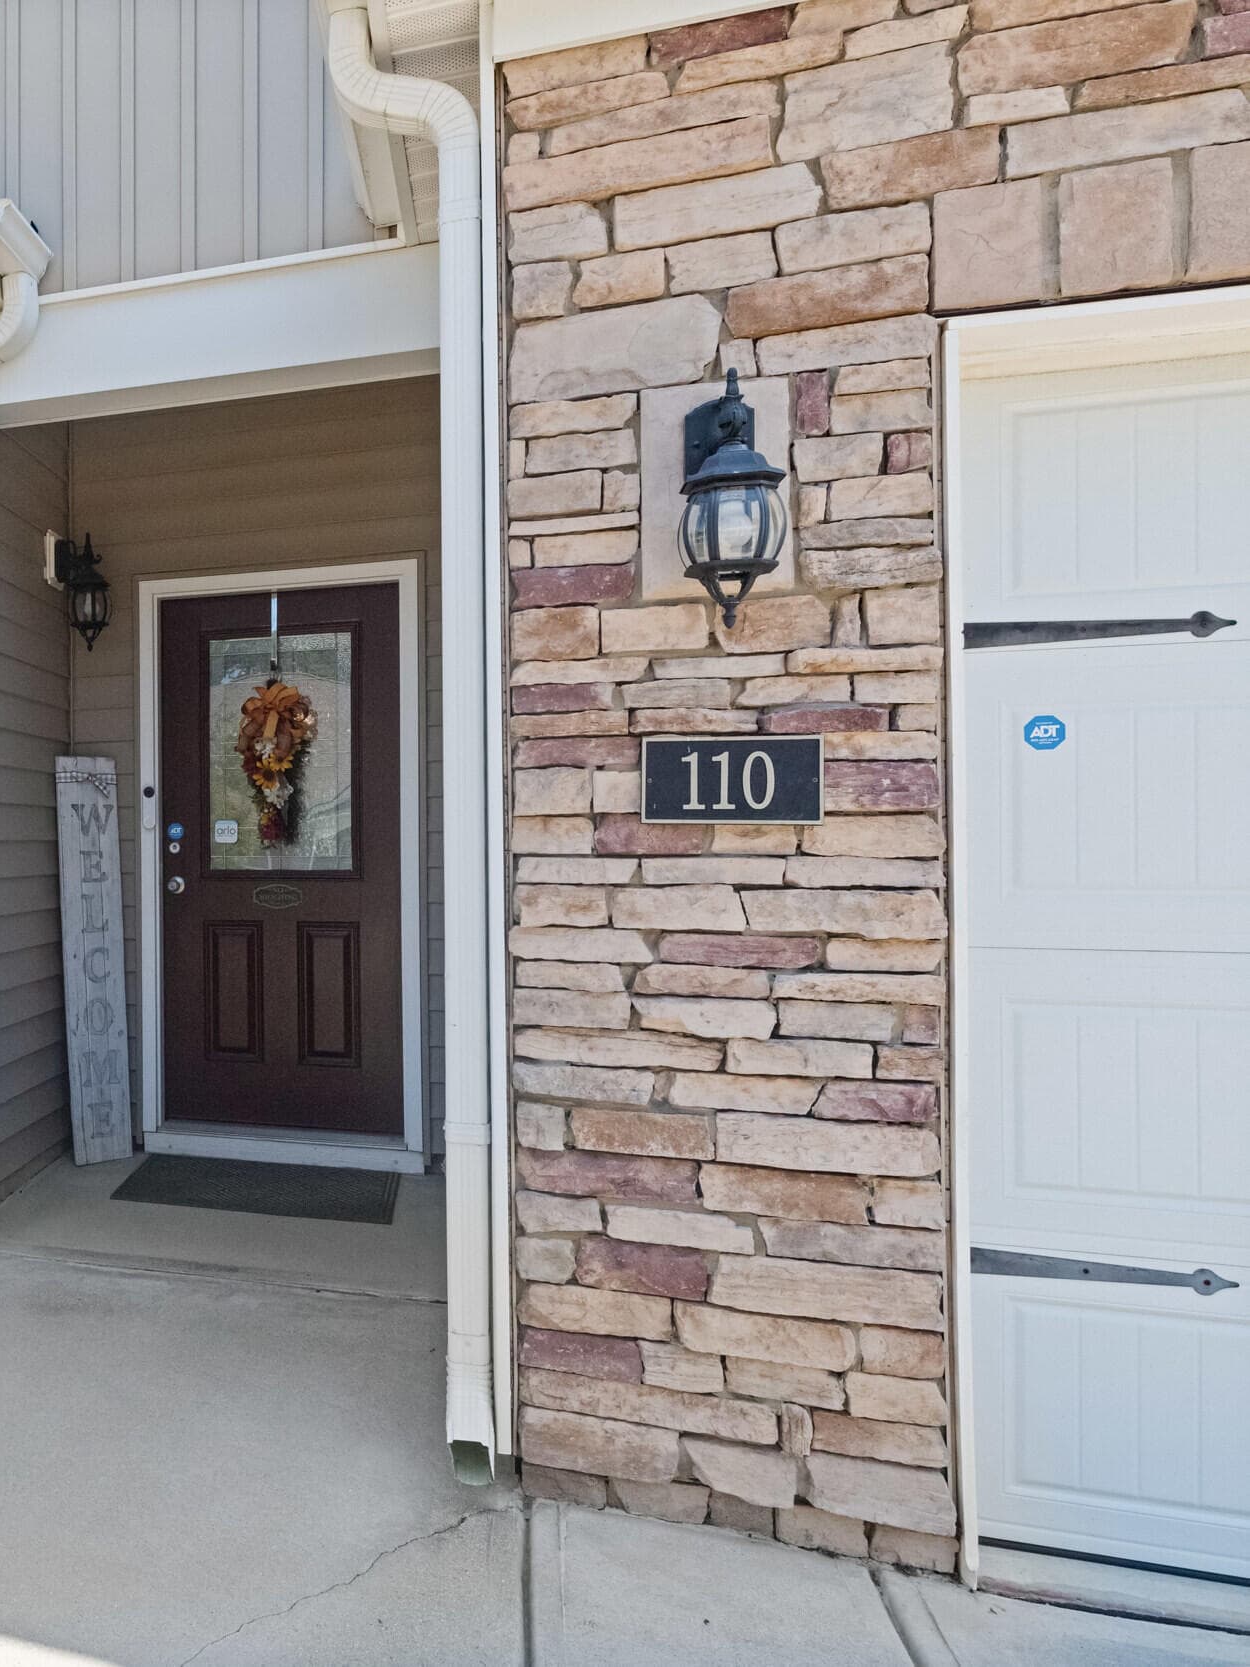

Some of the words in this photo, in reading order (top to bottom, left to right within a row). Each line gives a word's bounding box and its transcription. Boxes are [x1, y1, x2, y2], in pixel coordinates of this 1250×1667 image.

[1030, 725, 1060, 738] ADT
[681, 750, 775, 810] 110
[216, 826, 237, 835] arlo
[71, 803, 121, 1140] WELCOME
